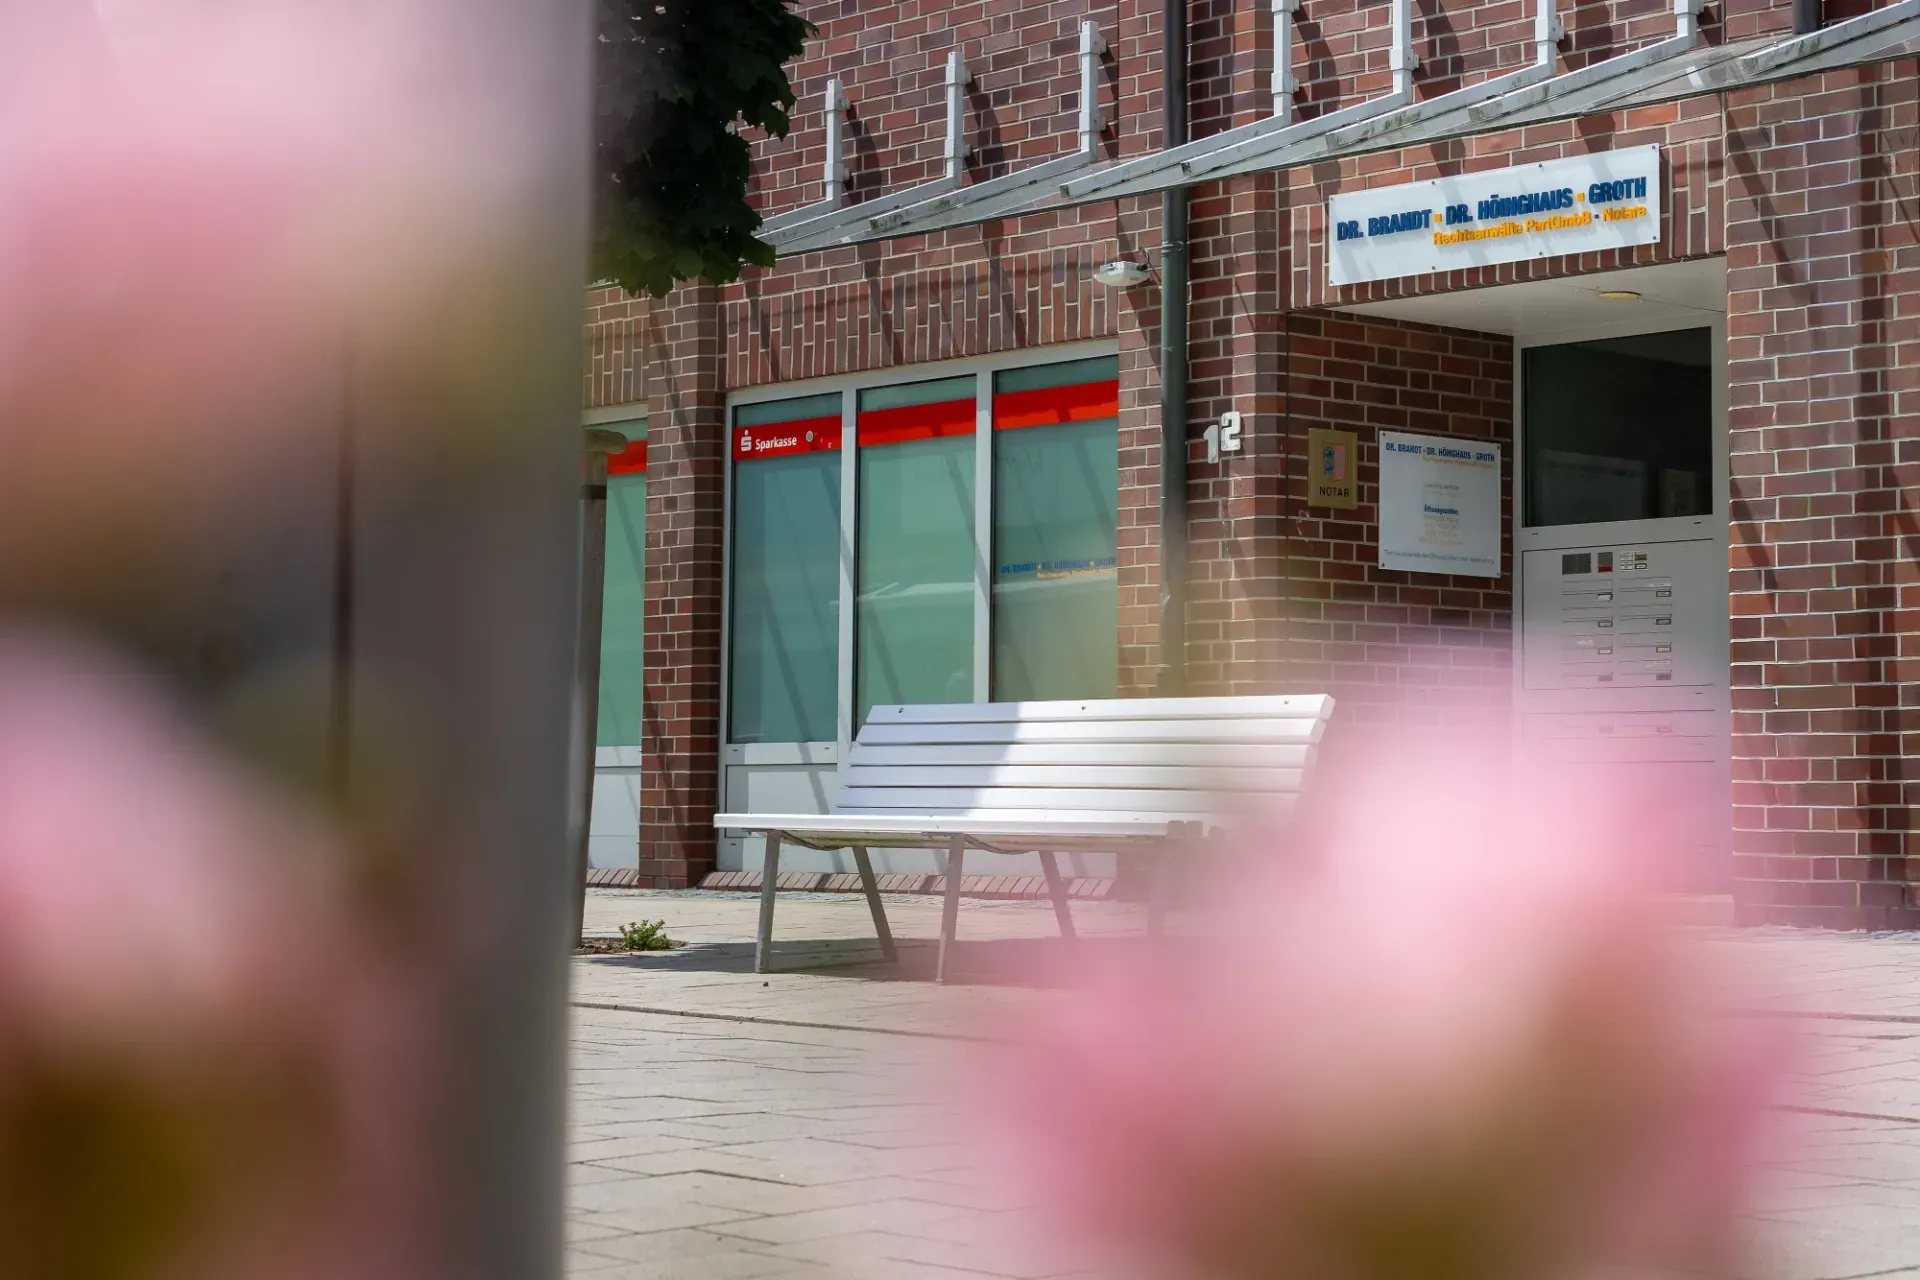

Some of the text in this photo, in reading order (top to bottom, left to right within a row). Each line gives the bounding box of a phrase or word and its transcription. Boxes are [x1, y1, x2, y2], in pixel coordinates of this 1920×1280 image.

[1337, 176, 1647, 241] DR. BRANDT DR. HÖINGHAUS GROTH
[1433, 205, 1647, 246] Rechtsanwälte PartGmbB Notare
[755, 436, 798, 453] Sparkasse
[1203, 411, 1241, 464] 12
[1385, 442, 1397, 451] DR.
[1398, 443, 1422, 455] BRANDT
[1427, 446, 1437, 456] DR.
[1476, 452, 1495, 462] GROTH
[1319, 486, 1350, 498] NOTAR
